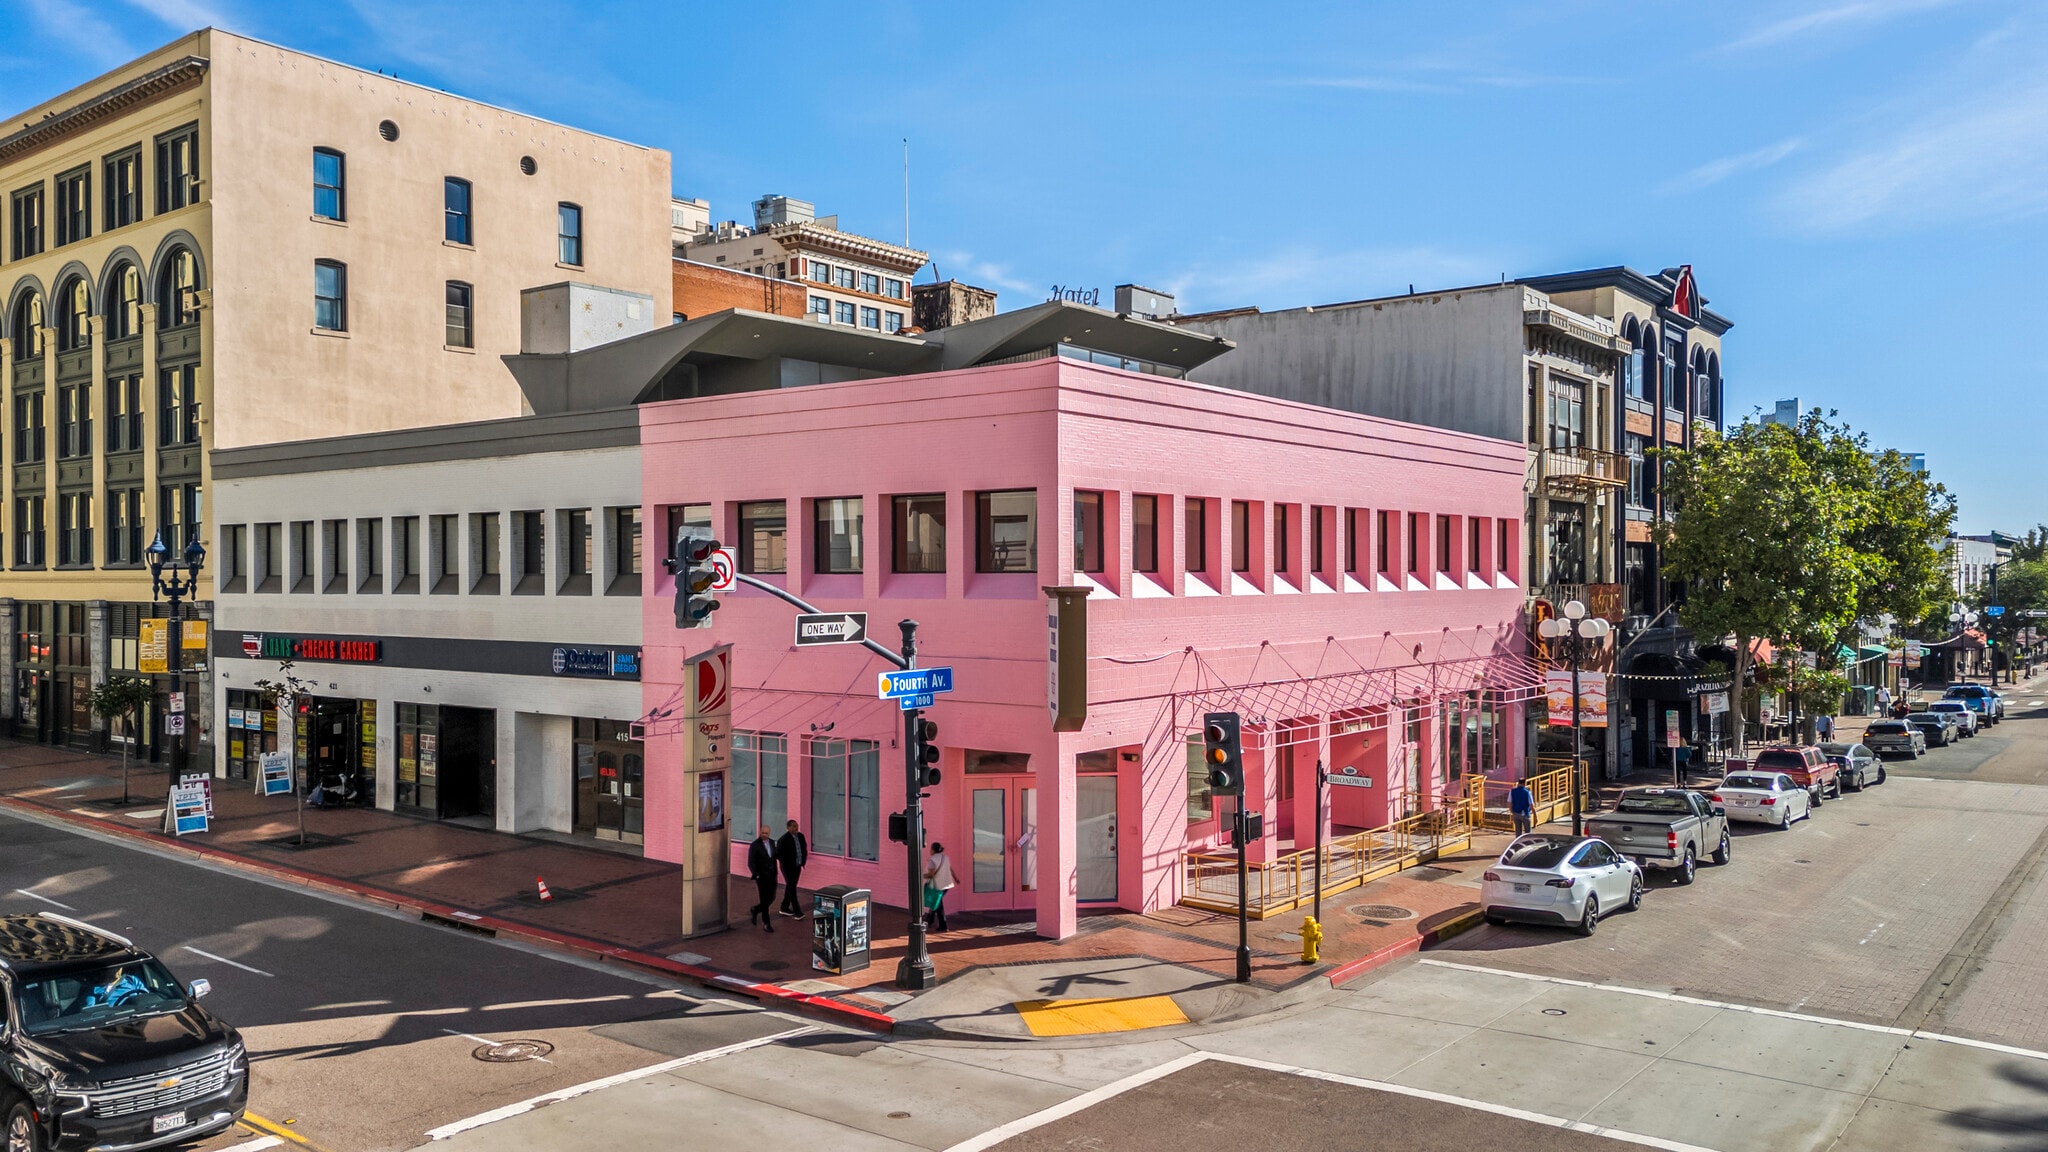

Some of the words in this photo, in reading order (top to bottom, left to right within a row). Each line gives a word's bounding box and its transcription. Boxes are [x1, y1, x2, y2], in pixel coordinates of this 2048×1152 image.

[807, 624, 824, 635] ONE
[827, 624, 845, 634] WAY
[154, 630, 166, 660] CENTER
[265, 638, 292, 657] LOANS
[302, 639, 337, 659] CHECKS
[340, 640, 377, 661] CASHED
[141, 643, 153, 660] CITY
[915, 695, 931, 706] 1000
[616, 732, 629, 742] 415
[1330, 776, 1369, 786] BROADWAY
